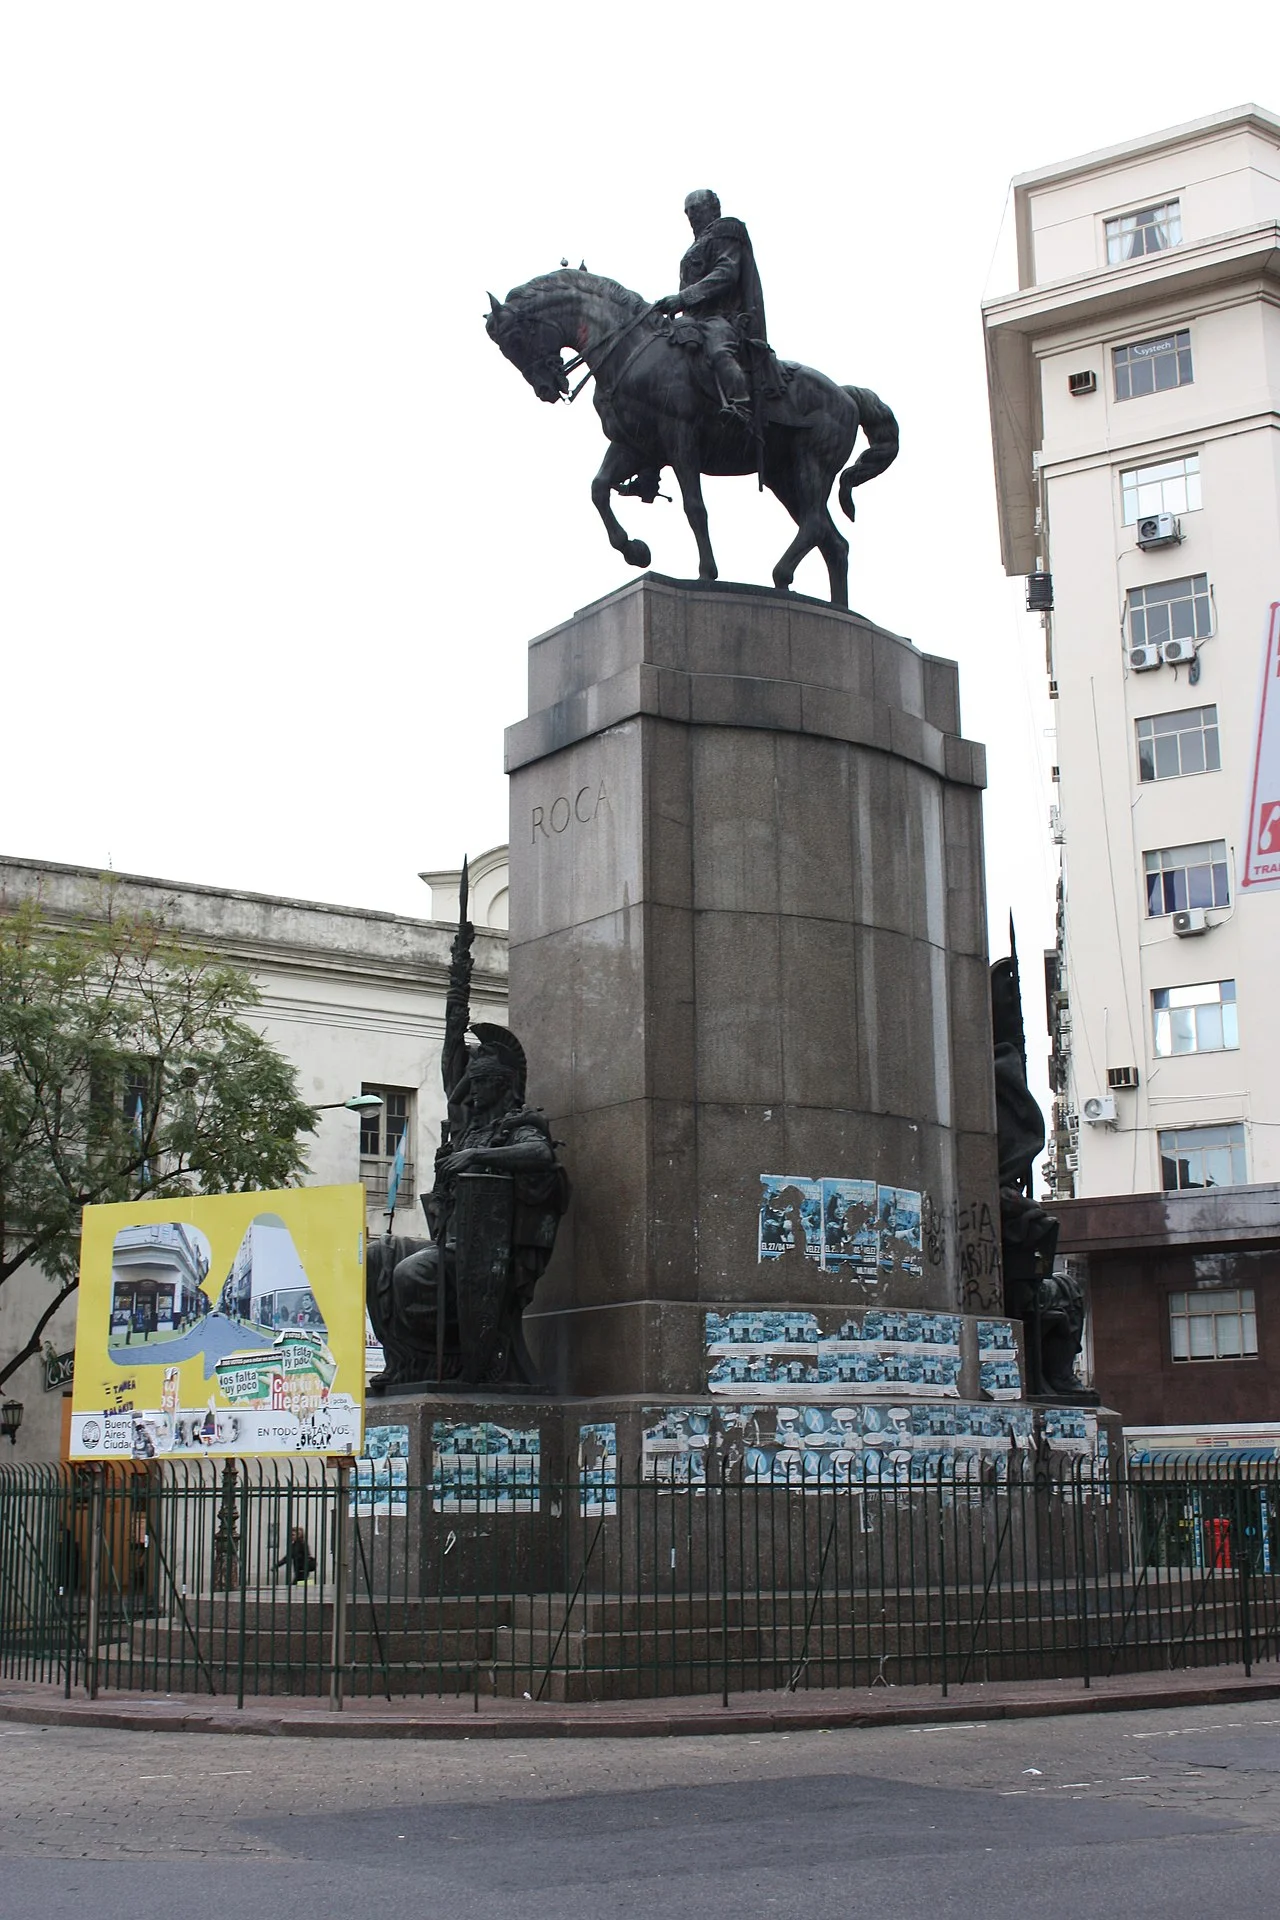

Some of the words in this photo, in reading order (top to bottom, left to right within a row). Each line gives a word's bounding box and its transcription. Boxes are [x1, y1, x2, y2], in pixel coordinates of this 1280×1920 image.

[531, 780, 613, 845] ROCA
[1254, 863, 1280, 876] TRA
[235, 1370, 257, 1383] falta
[236, 1381, 257, 1394] poco
[273, 1392, 320, 1412] llegam
[105, 1420, 132, 1429] Bueno
[104, 1430, 126, 1439] Aires
[257, 1428, 270, 1437] EN
[272, 1427, 298, 1436] TODO
